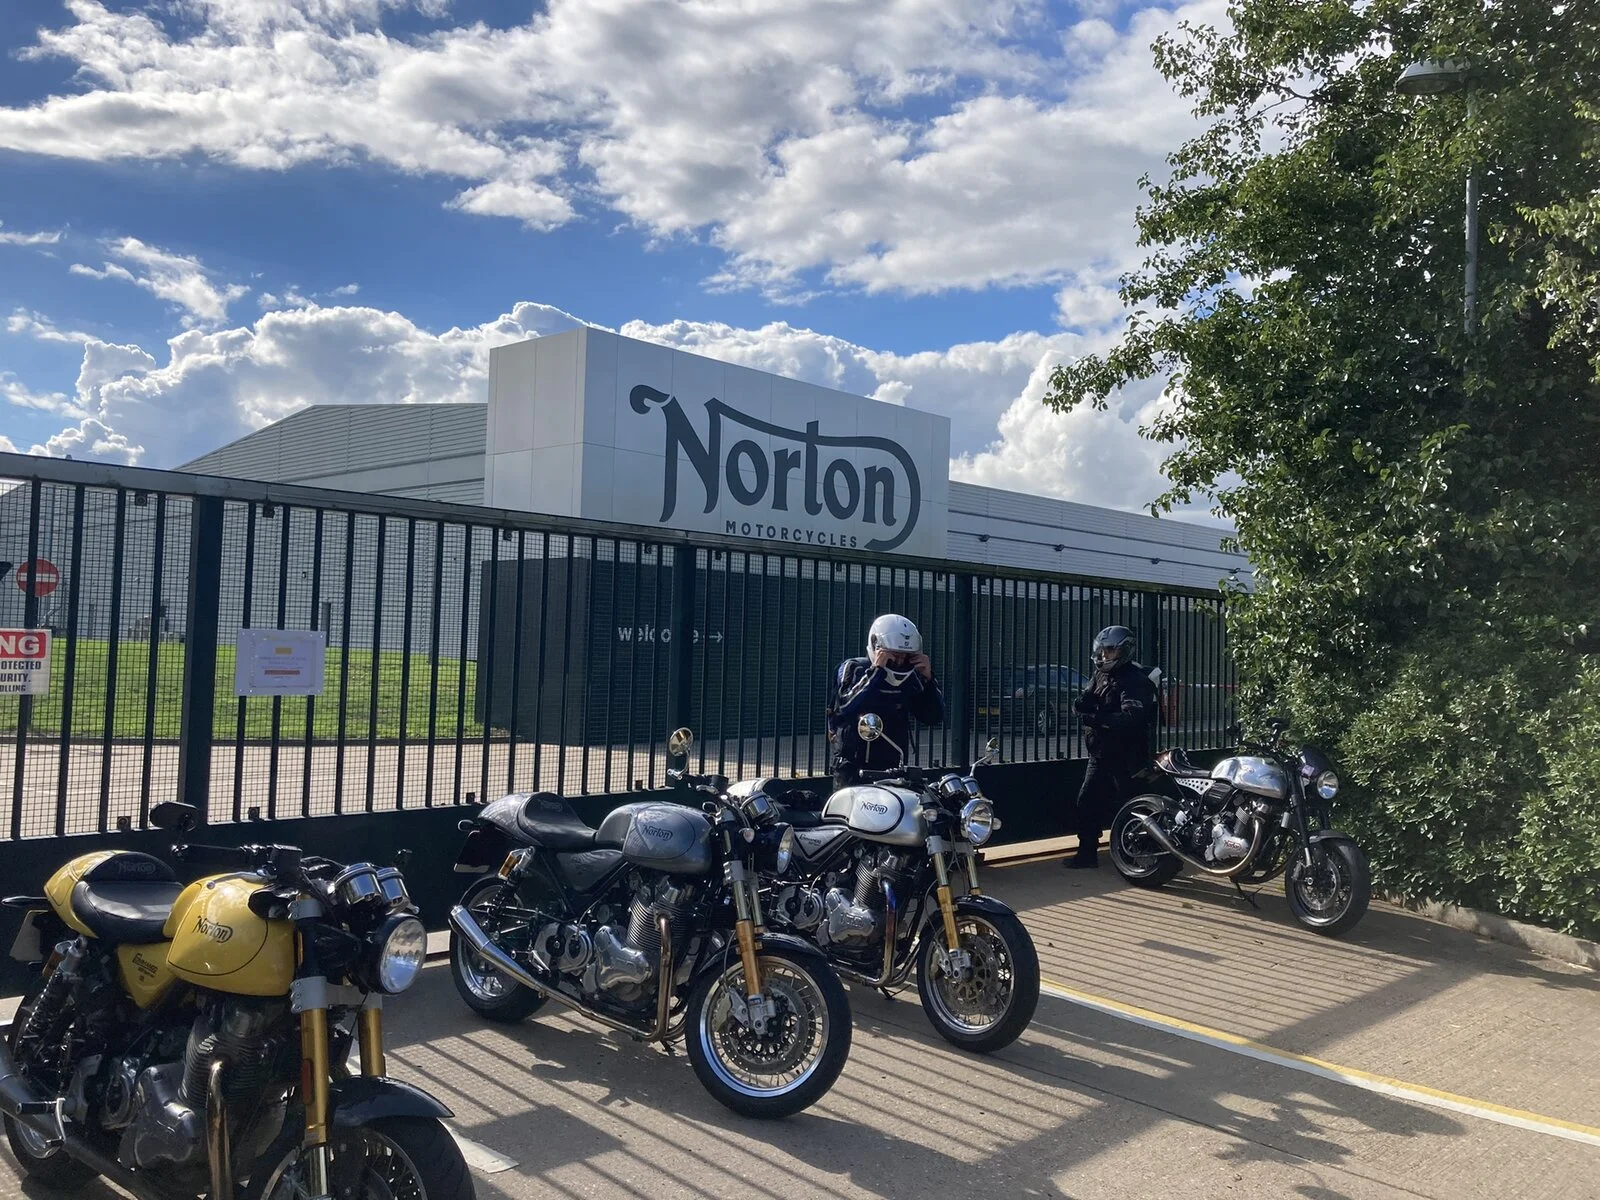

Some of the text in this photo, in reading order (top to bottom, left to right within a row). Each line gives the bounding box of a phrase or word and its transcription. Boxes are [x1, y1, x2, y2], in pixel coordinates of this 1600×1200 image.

[629, 384, 921, 551] Norton
[725, 520, 857, 548] MOTORCYCLES
[618, 624, 699, 644] welcoe
[862, 801, 888, 815] Norton
[643, 824, 674, 841] Norton
[191, 915, 234, 944] Norton
